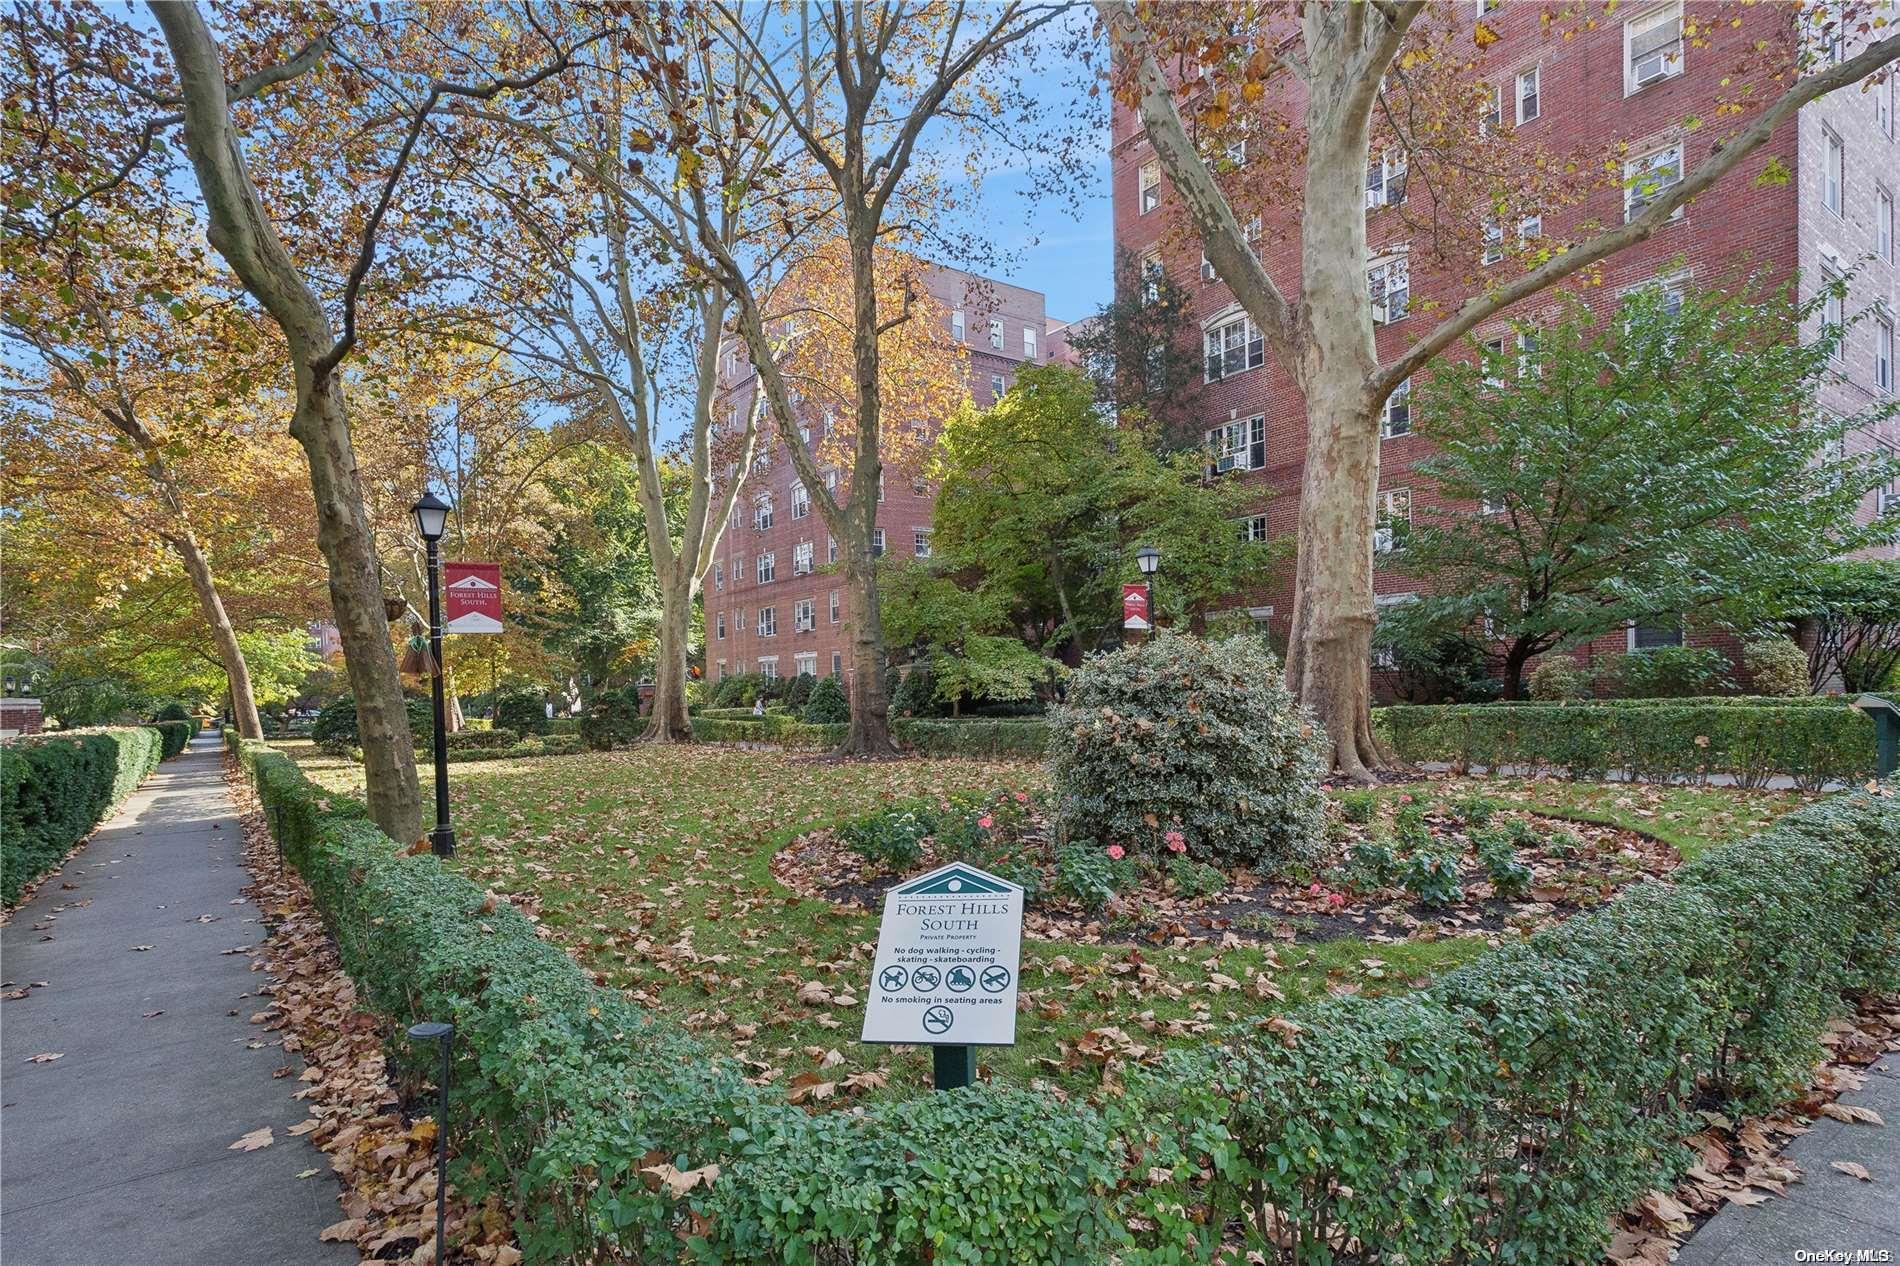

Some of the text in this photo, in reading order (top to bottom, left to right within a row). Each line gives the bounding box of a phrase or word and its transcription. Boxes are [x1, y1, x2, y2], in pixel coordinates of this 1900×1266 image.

[897, 902, 1009, 915] FOREST HILLS
[920, 918, 978, 931] SOUTH
[907, 947, 924, 955] dog
[926, 947, 960, 955] walking
[966, 947, 996, 955] cycling
[897, 956, 928, 964] skating
[934, 956, 995, 964] skateboarding
[895, 996, 932, 1004] smoking
[944, 996, 977, 1005] seating
